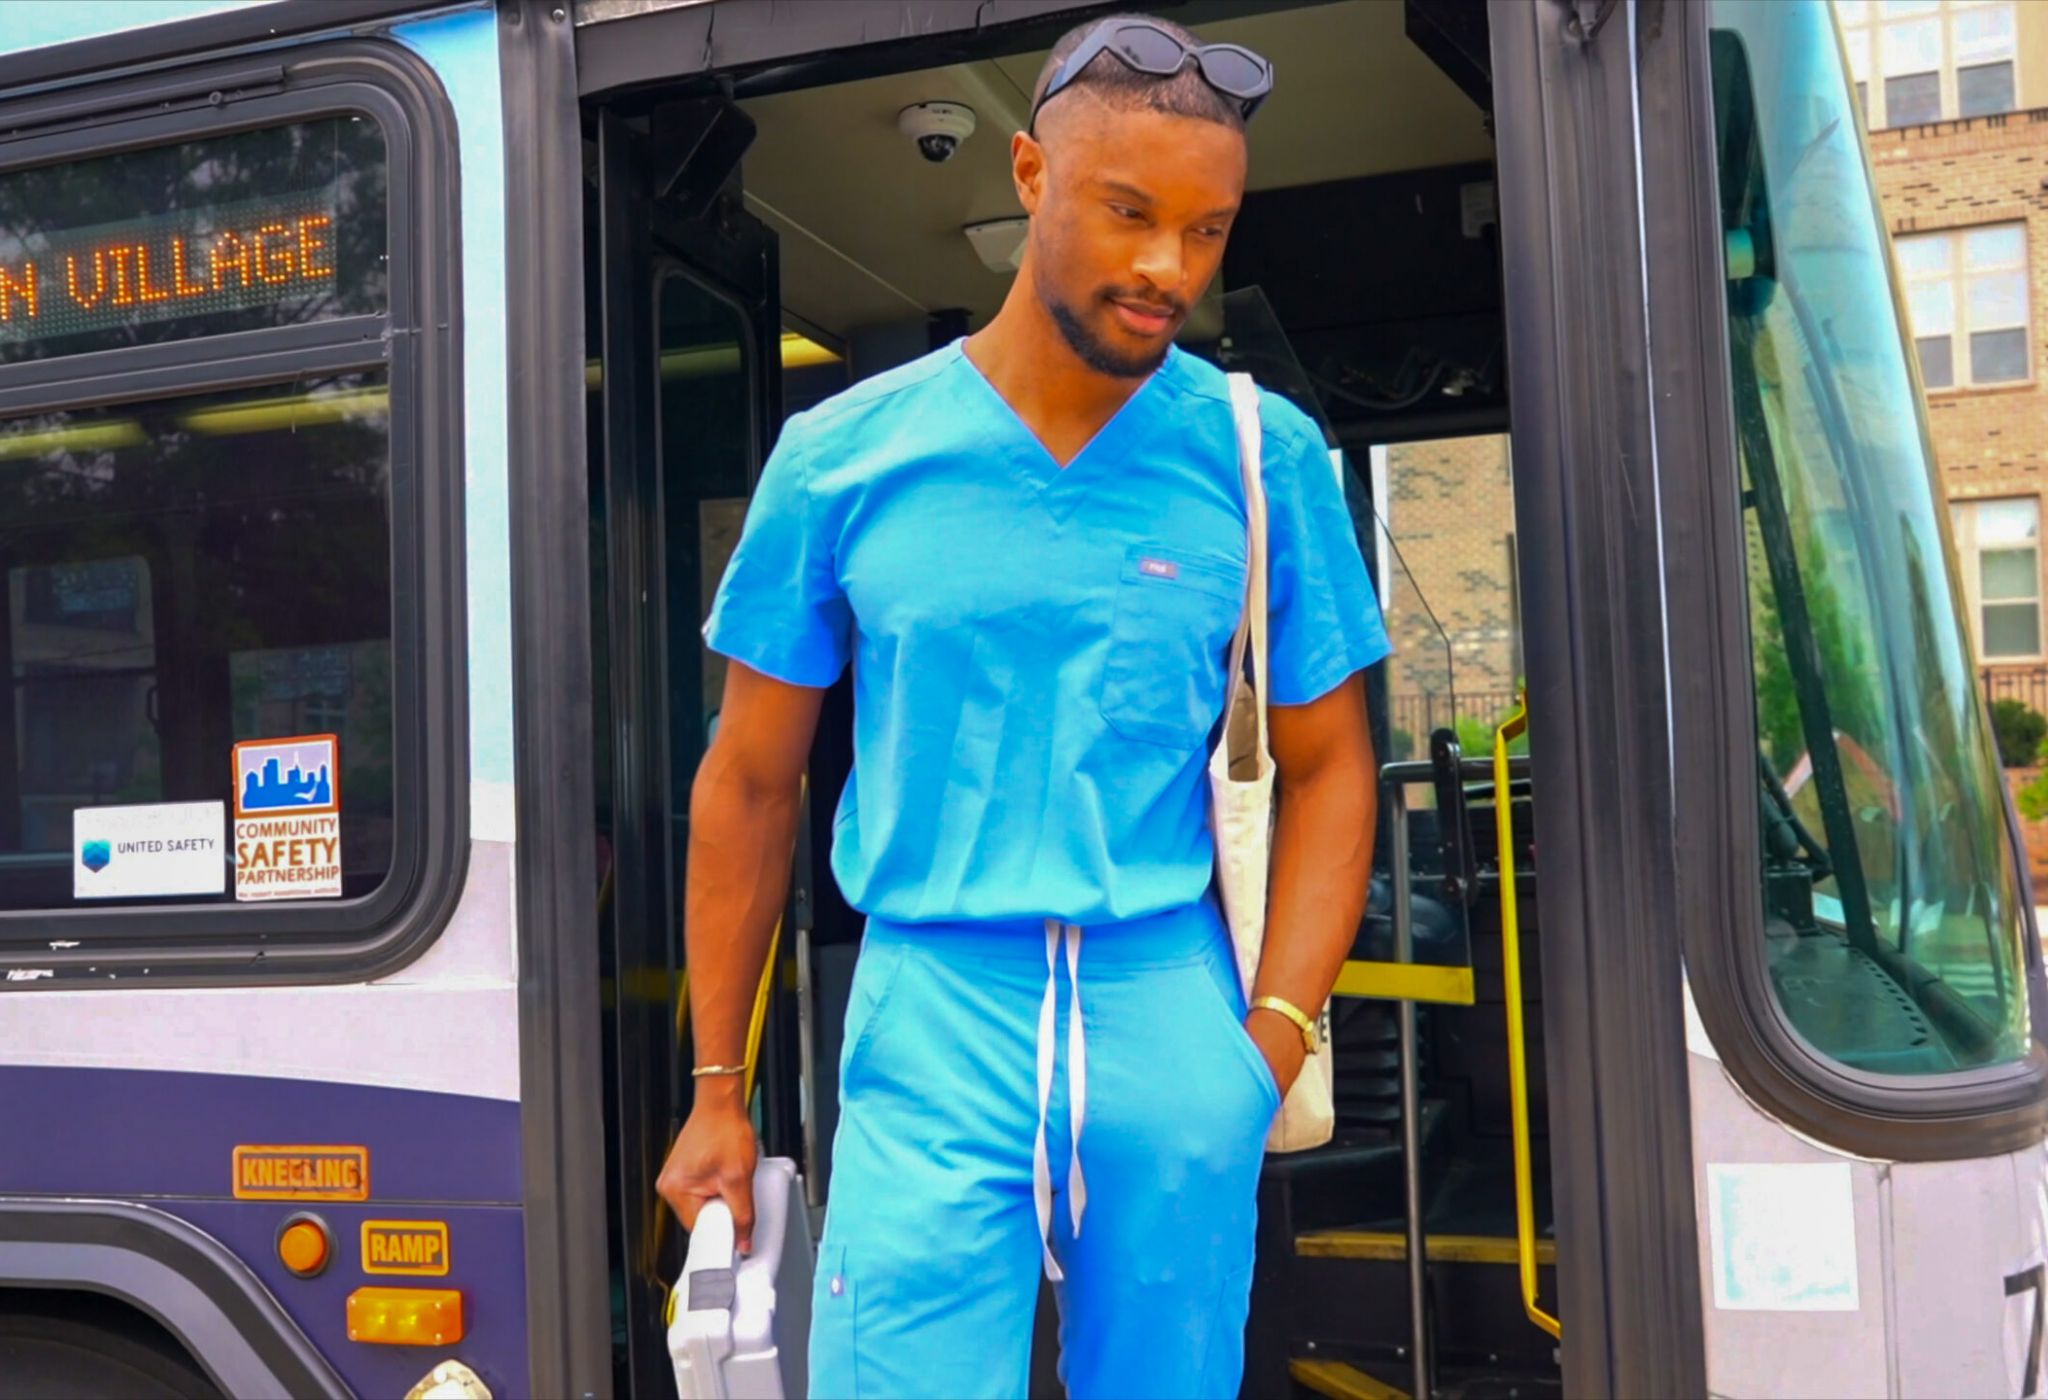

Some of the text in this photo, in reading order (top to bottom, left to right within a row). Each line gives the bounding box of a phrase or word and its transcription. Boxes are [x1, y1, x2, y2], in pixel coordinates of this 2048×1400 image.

[67, 216, 332, 309] VILLAGE
[236, 818, 336, 839] COMMUNITY
[118, 838, 214, 854] UNITED SAFETY
[237, 838, 337, 868] SAFETY
[237, 865, 339, 885] PARTNERSHIP
[243, 1158, 358, 1187] KNEELING
[371, 1234, 440, 1263] RAMP
